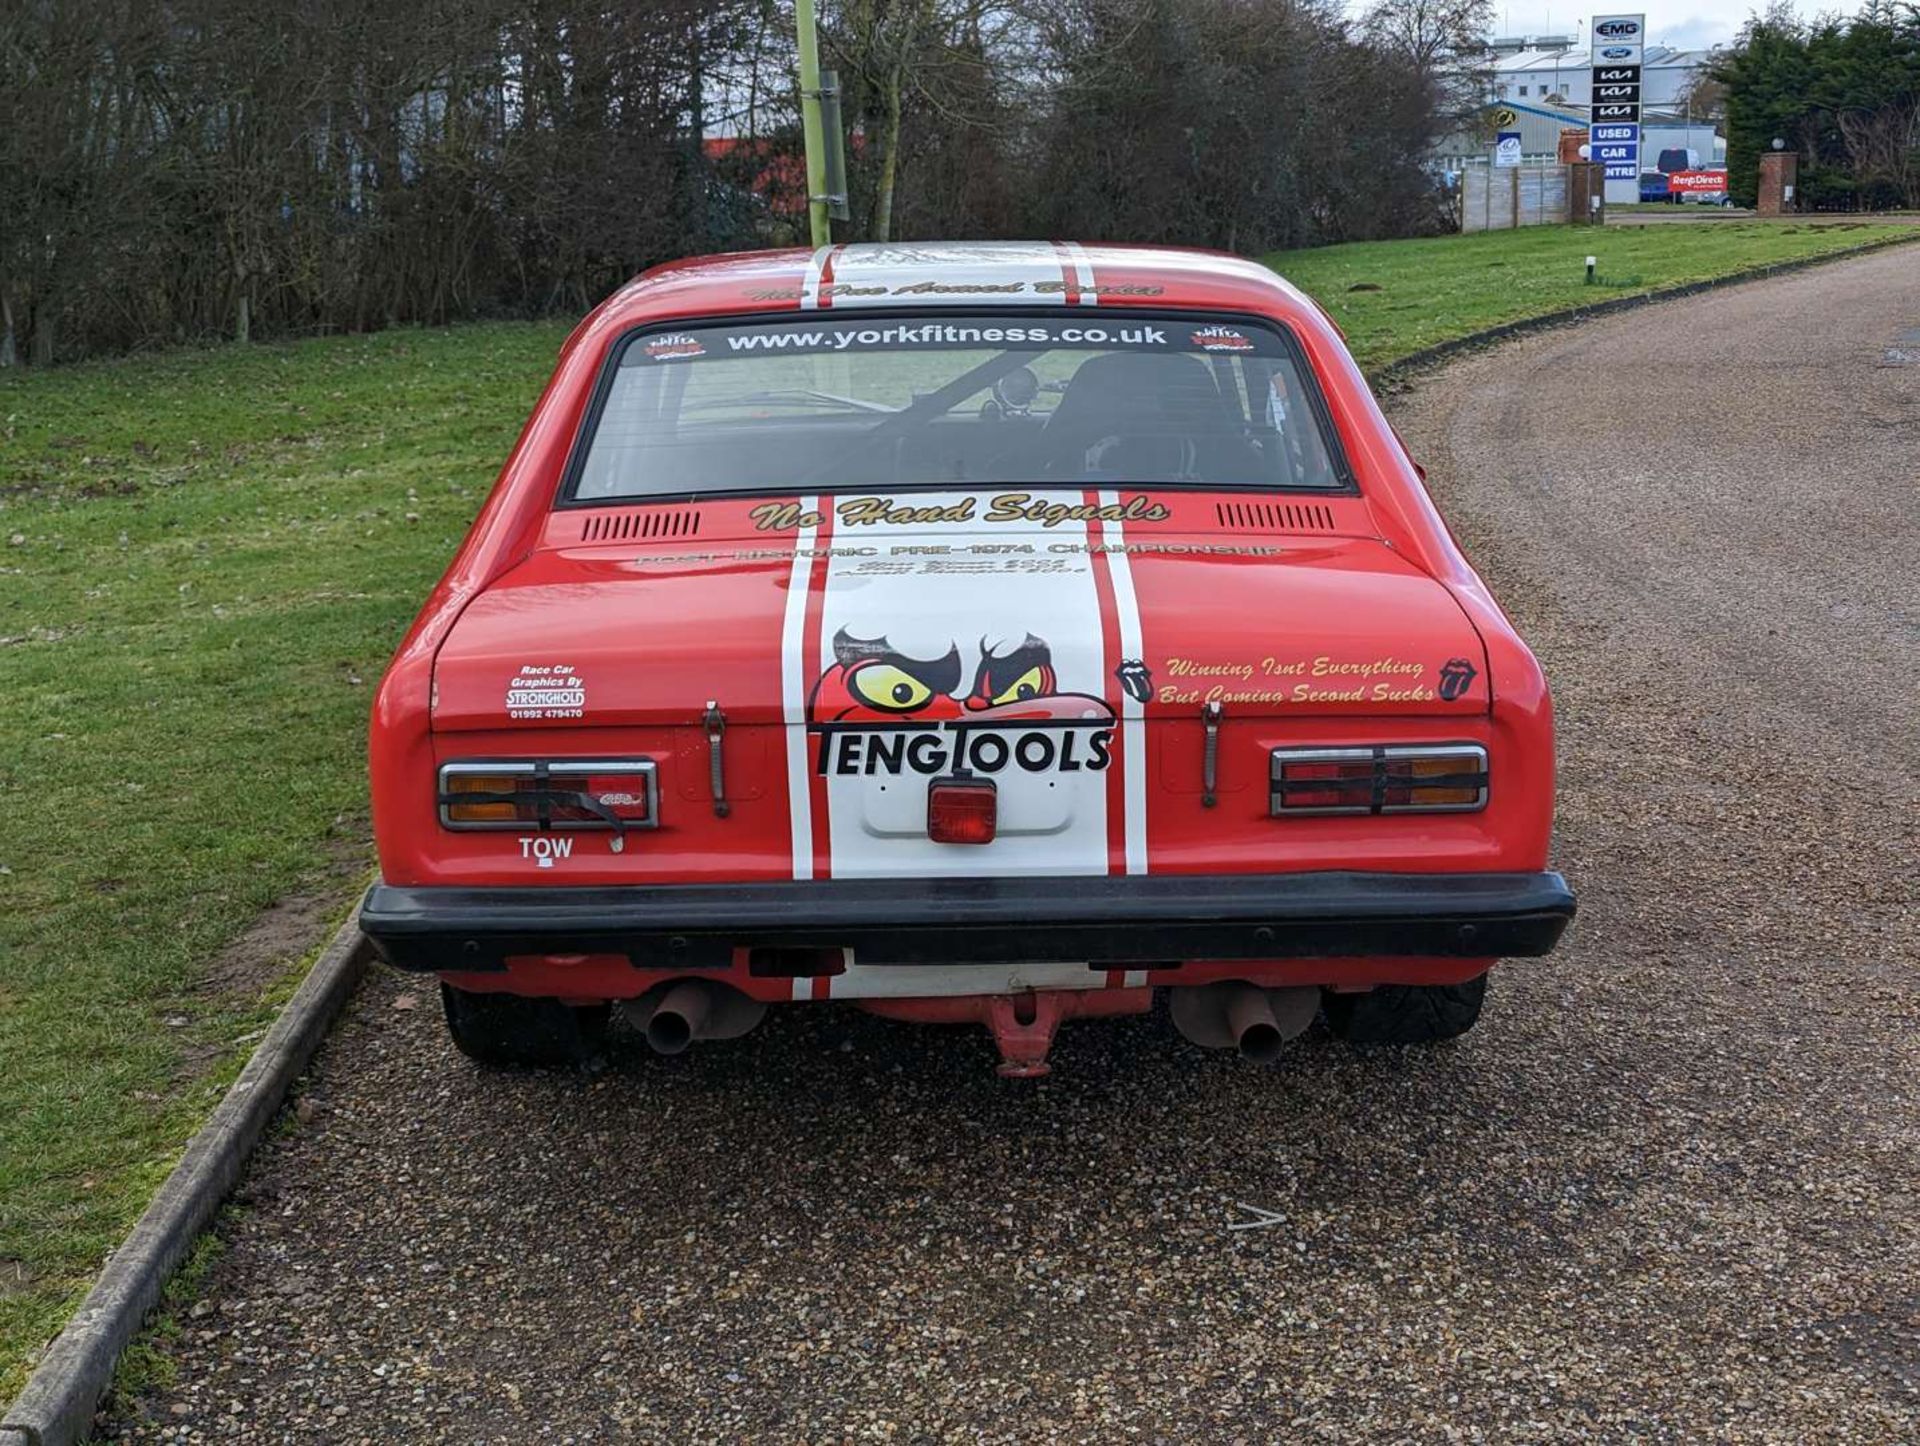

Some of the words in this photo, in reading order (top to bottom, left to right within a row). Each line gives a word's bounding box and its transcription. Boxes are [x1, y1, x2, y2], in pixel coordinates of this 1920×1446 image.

[1596, 23, 1638, 36] EMG
[1598, 128, 1632, 138] USED
[1601, 148, 1627, 158] CAR
[1606, 166, 1635, 177] NTRE
[727, 324, 1168, 351] www.yorkfitness.co.uk
[749, 501, 825, 531] No
[836, 496, 977, 526] Hand
[984, 493, 1170, 528] Signals
[732, 547, 879, 561] HISTORIC
[890, 544, 1036, 556] PRE-1974
[1047, 543, 1283, 557] CHAMPIONSHIP
[520, 665, 551, 675] Race
[553, 665, 575, 674] Car
[1166, 658, 1254, 679] Winning
[1261, 657, 1306, 676] Isnt
[1312, 656, 1425, 678] Everything
[511, 677, 564, 688] Graphics
[567, 676, 583, 688] By
[506, 688, 585, 707] STRONGHOLD
[1159, 685, 1199, 704] But
[1205, 684, 1283, 705] Coming
[1292, 683, 1365, 703] Second
[1370, 683, 1436, 702] Sucks
[510, 709, 543, 719] 01992
[518, 837, 573, 858] TOW
